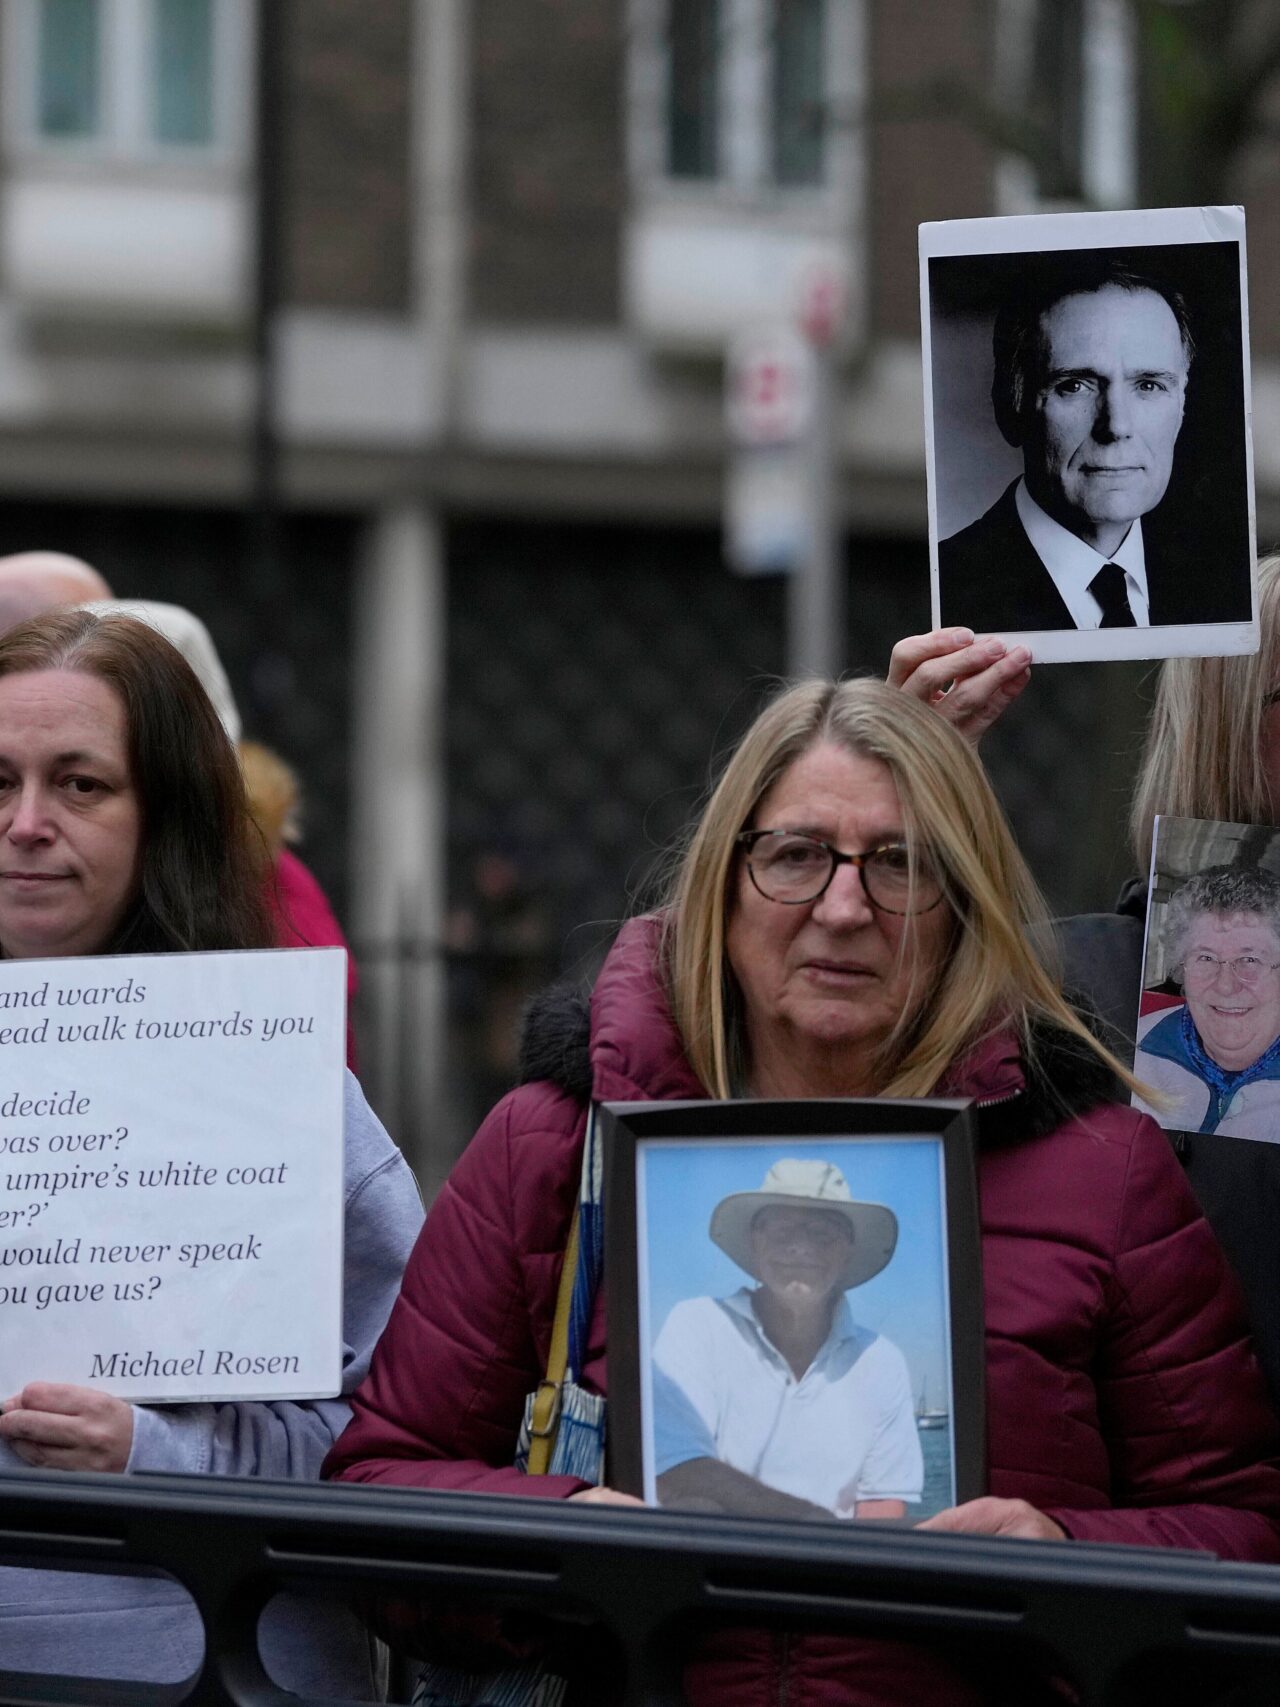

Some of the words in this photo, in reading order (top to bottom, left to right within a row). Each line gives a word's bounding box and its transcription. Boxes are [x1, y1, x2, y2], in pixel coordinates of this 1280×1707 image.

[57, 978, 147, 1006] wards
[57, 1015, 127, 1043] walk
[135, 1010, 254, 1040] towards
[261, 1016, 314, 1042] you
[0, 1090, 91, 1118] decide
[48, 1126, 129, 1153] over?
[6, 1162, 129, 1197] umpire’s
[138, 1160, 218, 1188] white
[226, 1162, 288, 1185] coat
[89, 1244, 172, 1264] never
[178, 1234, 262, 1269] speak
[35, 1283, 105, 1311] gave
[114, 1275, 162, 1301] us?
[89, 1349, 205, 1378] Michael
[213, 1351, 299, 1375] Rosen
